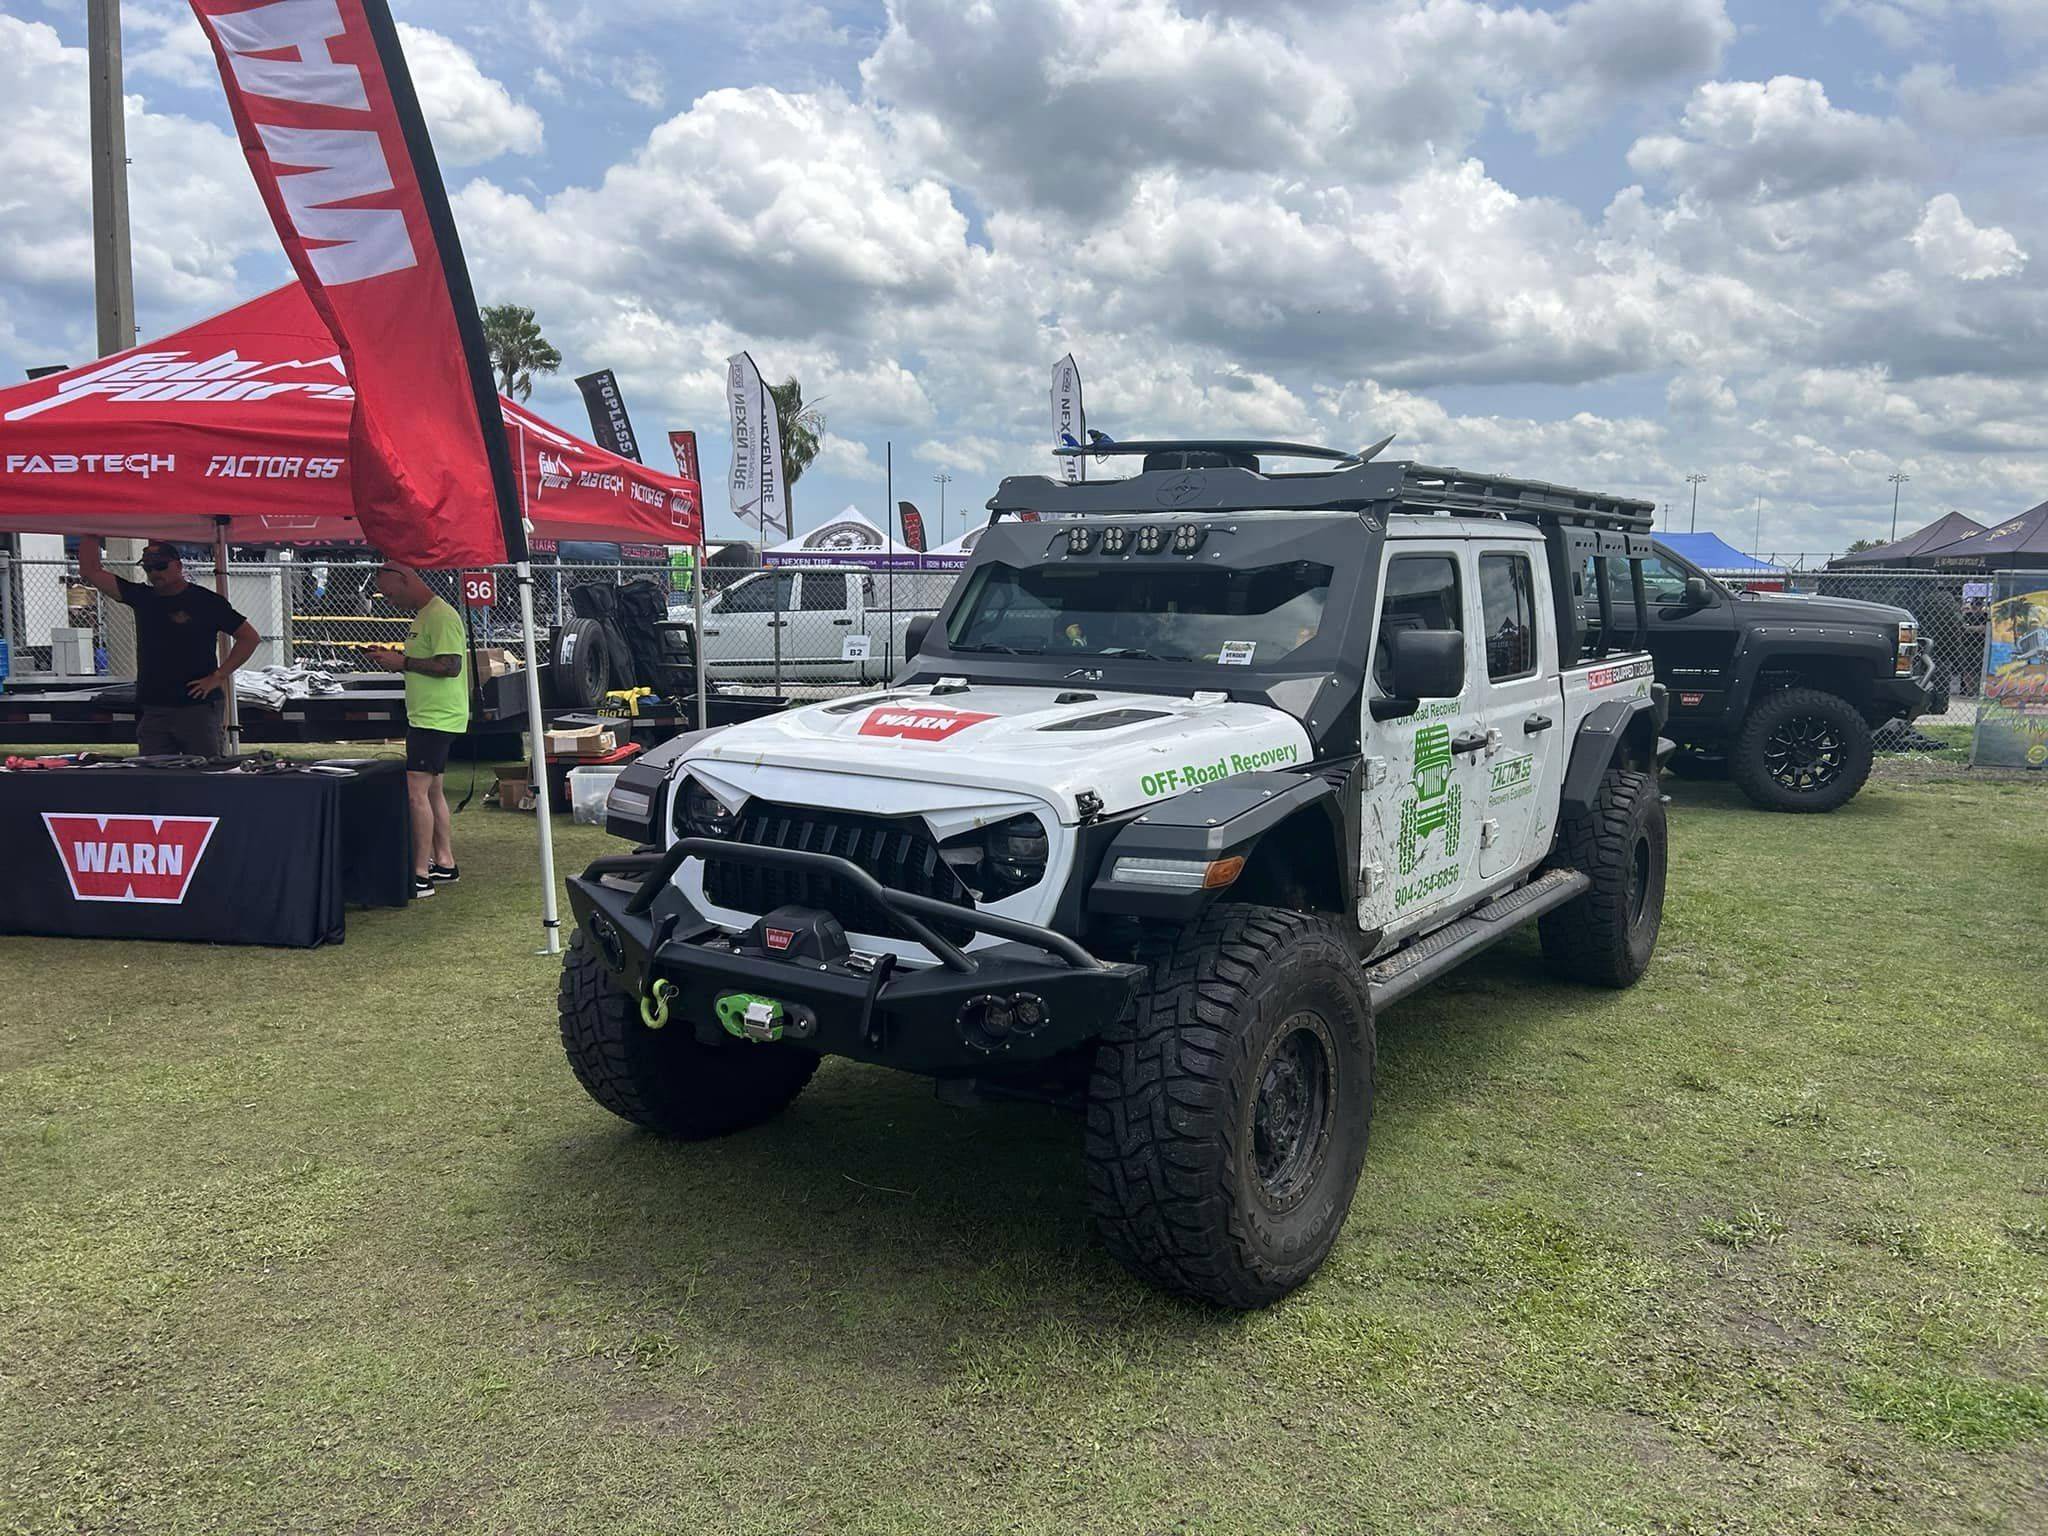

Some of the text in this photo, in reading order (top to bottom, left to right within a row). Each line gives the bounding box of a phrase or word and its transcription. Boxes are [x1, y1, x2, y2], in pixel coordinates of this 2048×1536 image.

[597, 374, 633, 453] TOPLESS
[6, 452, 176, 479] FABTECH
[204, 455, 304, 479] FACTOR
[577, 471, 624, 496] FABTECH
[763, 468, 775, 503] TIRE
[781, 558, 812, 566] NEXEN
[466, 581, 492, 599] 36
[876, 714, 958, 731] WARN
[1140, 743, 1298, 797] OFF-Road Recovery
[74, 841, 184, 877] WARN
[1395, 863, 1460, 910] 904-254-6856
